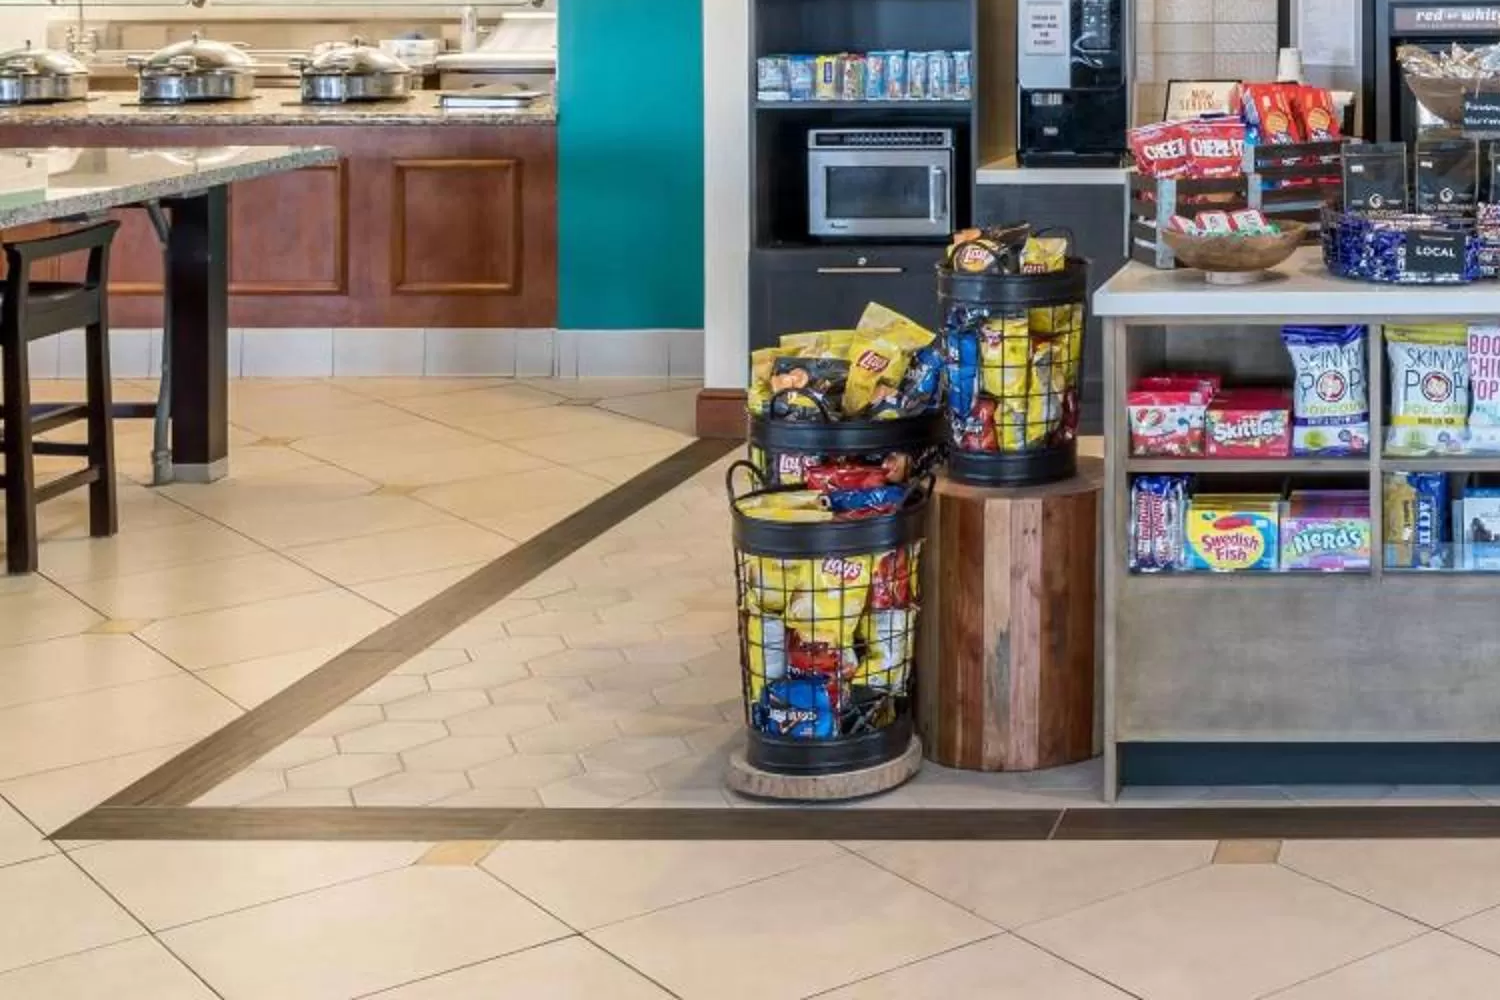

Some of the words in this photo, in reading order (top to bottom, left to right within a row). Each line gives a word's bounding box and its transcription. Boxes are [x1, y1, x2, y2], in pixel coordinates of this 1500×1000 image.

[1415, 9, 1443, 21] red
[1415, 245, 1456, 258] LOCAL
[1300, 347, 1362, 370] SKINNY
[1405, 347, 1466, 370] SKINNY
[1300, 368, 1362, 402] POP
[1213, 413, 1284, 441] Skittles
[1201, 531, 1260, 552] Swedish
[1215, 547, 1248, 561] Fish
